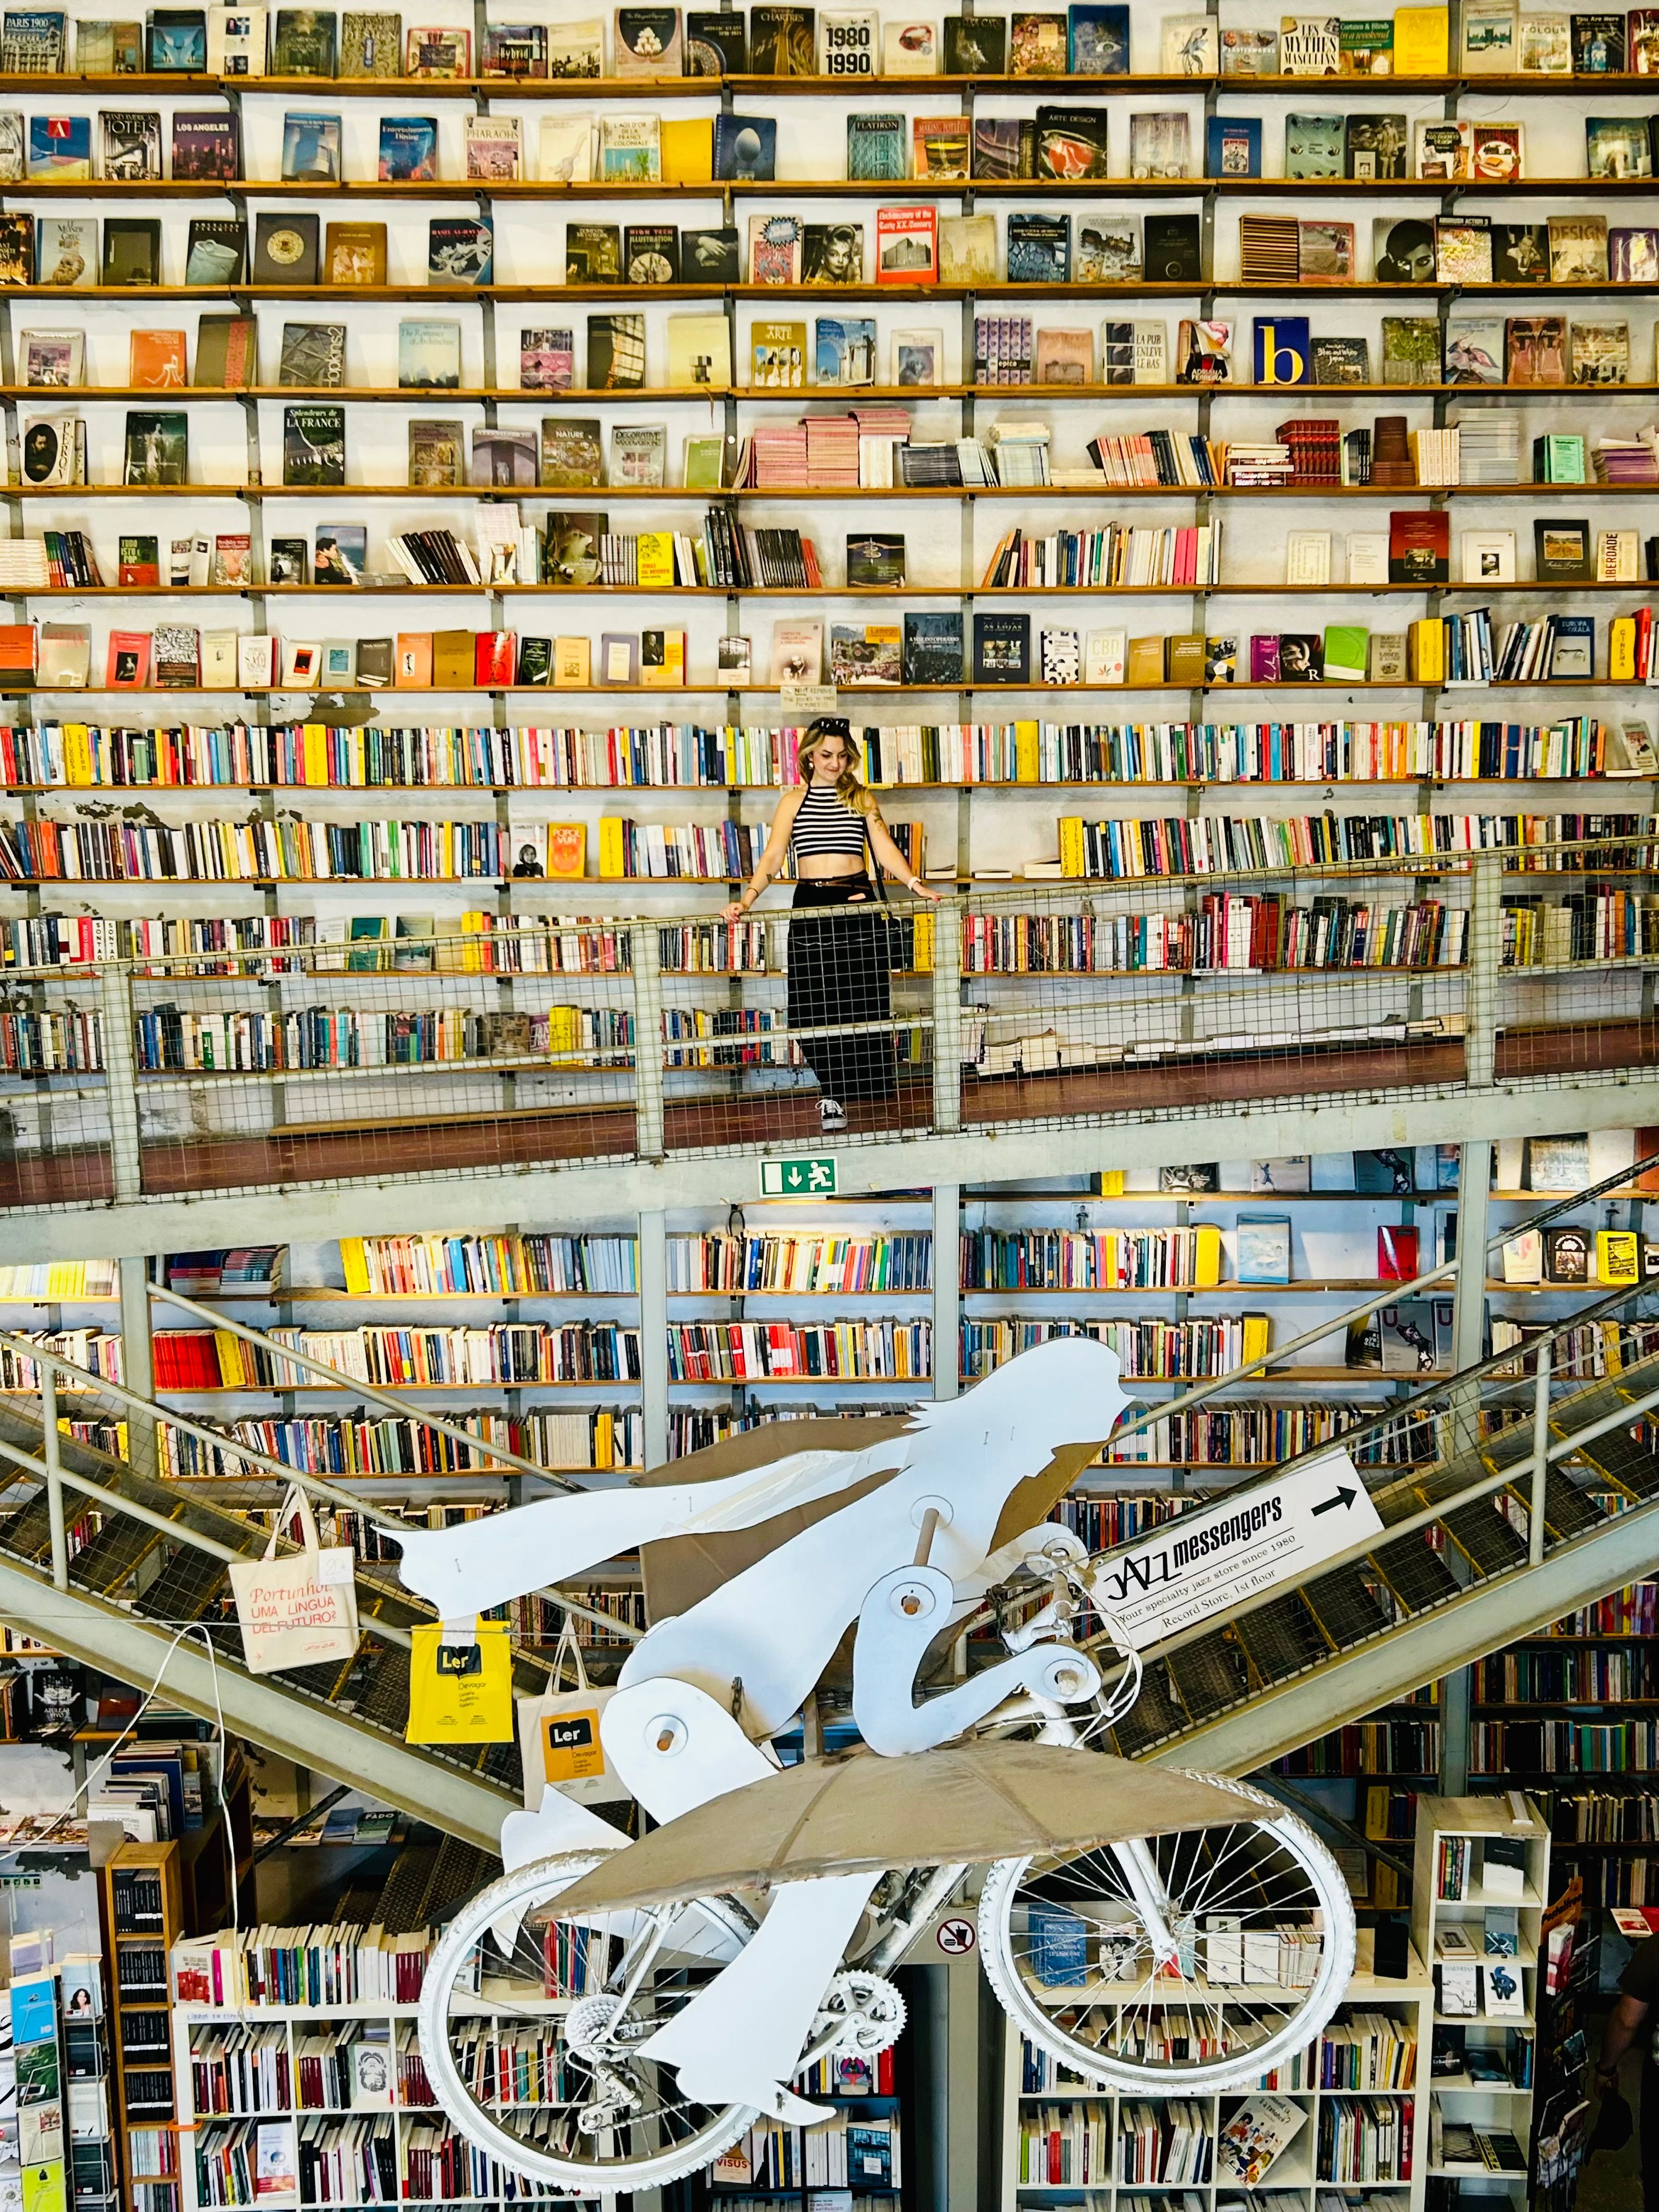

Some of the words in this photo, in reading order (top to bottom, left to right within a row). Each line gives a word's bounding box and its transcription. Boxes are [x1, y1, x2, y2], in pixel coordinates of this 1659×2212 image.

[761, 13, 804, 22] CHARTRES
[6, 18, 30, 28] PARIS
[31, 18, 49, 29] 1900
[1299, 24, 1318, 36] LES
[826, 27, 870, 47] 1980
[1282, 36, 1336, 53] MYTHES
[500, 47, 528, 60] Hybrid
[826, 53, 870, 75] 1990
[856, 120, 898, 129] FLATIRON
[1069, 115, 1097, 123] DESIGN
[176, 123, 192, 132] LOS
[193, 123, 229, 132] ANGELES
[466, 129, 519, 140] PHARAOHS
[1548, 225, 1608, 241] DESIGN
[766, 330, 792, 341] ARTE
[1136, 334, 1146, 345] LA
[1147, 334, 1161, 345] PUB
[1258, 325, 1304, 385] b
[1137, 359, 1146, 369] LE
[1146, 359, 1160, 369] BAS
[286, 418, 298, 428] LA
[301, 418, 341, 428] FRANCE
[556, 431, 584, 439] NATURE
[614, 431, 662, 440] DECORATIVE
[1092, 640, 1120, 655] CBD
[552, 828, 580, 837] POPOL
[556, 836, 577, 845] VUH
[1103, 1551, 1182, 1600] JAZZ
[1173, 1496, 1283, 1568] messengers
[1119, 1607, 1143, 1624] Your
[1145, 1586, 1189, 1612] specialty
[1192, 1576, 1212, 1592] jazz
[1213, 1563, 1240, 1579] store
[1242, 1550, 1268, 1566] since
[1270, 1535, 1296, 1551] 1980
[1162, 1604, 1201, 1629] Record
[1201, 1592, 1234, 1611] Store,
[1234, 1581, 1250, 1595] 1st
[1251, 1568, 1276, 1587] floor
[251, 1606, 279, 1619] UMA
[288, 1596, 336, 1616] LÍNGUA
[252, 1622, 276, 1634] DEL
[277, 1611, 337, 1632] FUTURO?
[442, 1651, 469, 1669] Ler
[458, 1682, 487, 1691] Devagar
[554, 1728, 580, 1743] Ler
[572, 1750, 597, 1758] Devagar
[716, 2159, 748, 2169] VISUS
